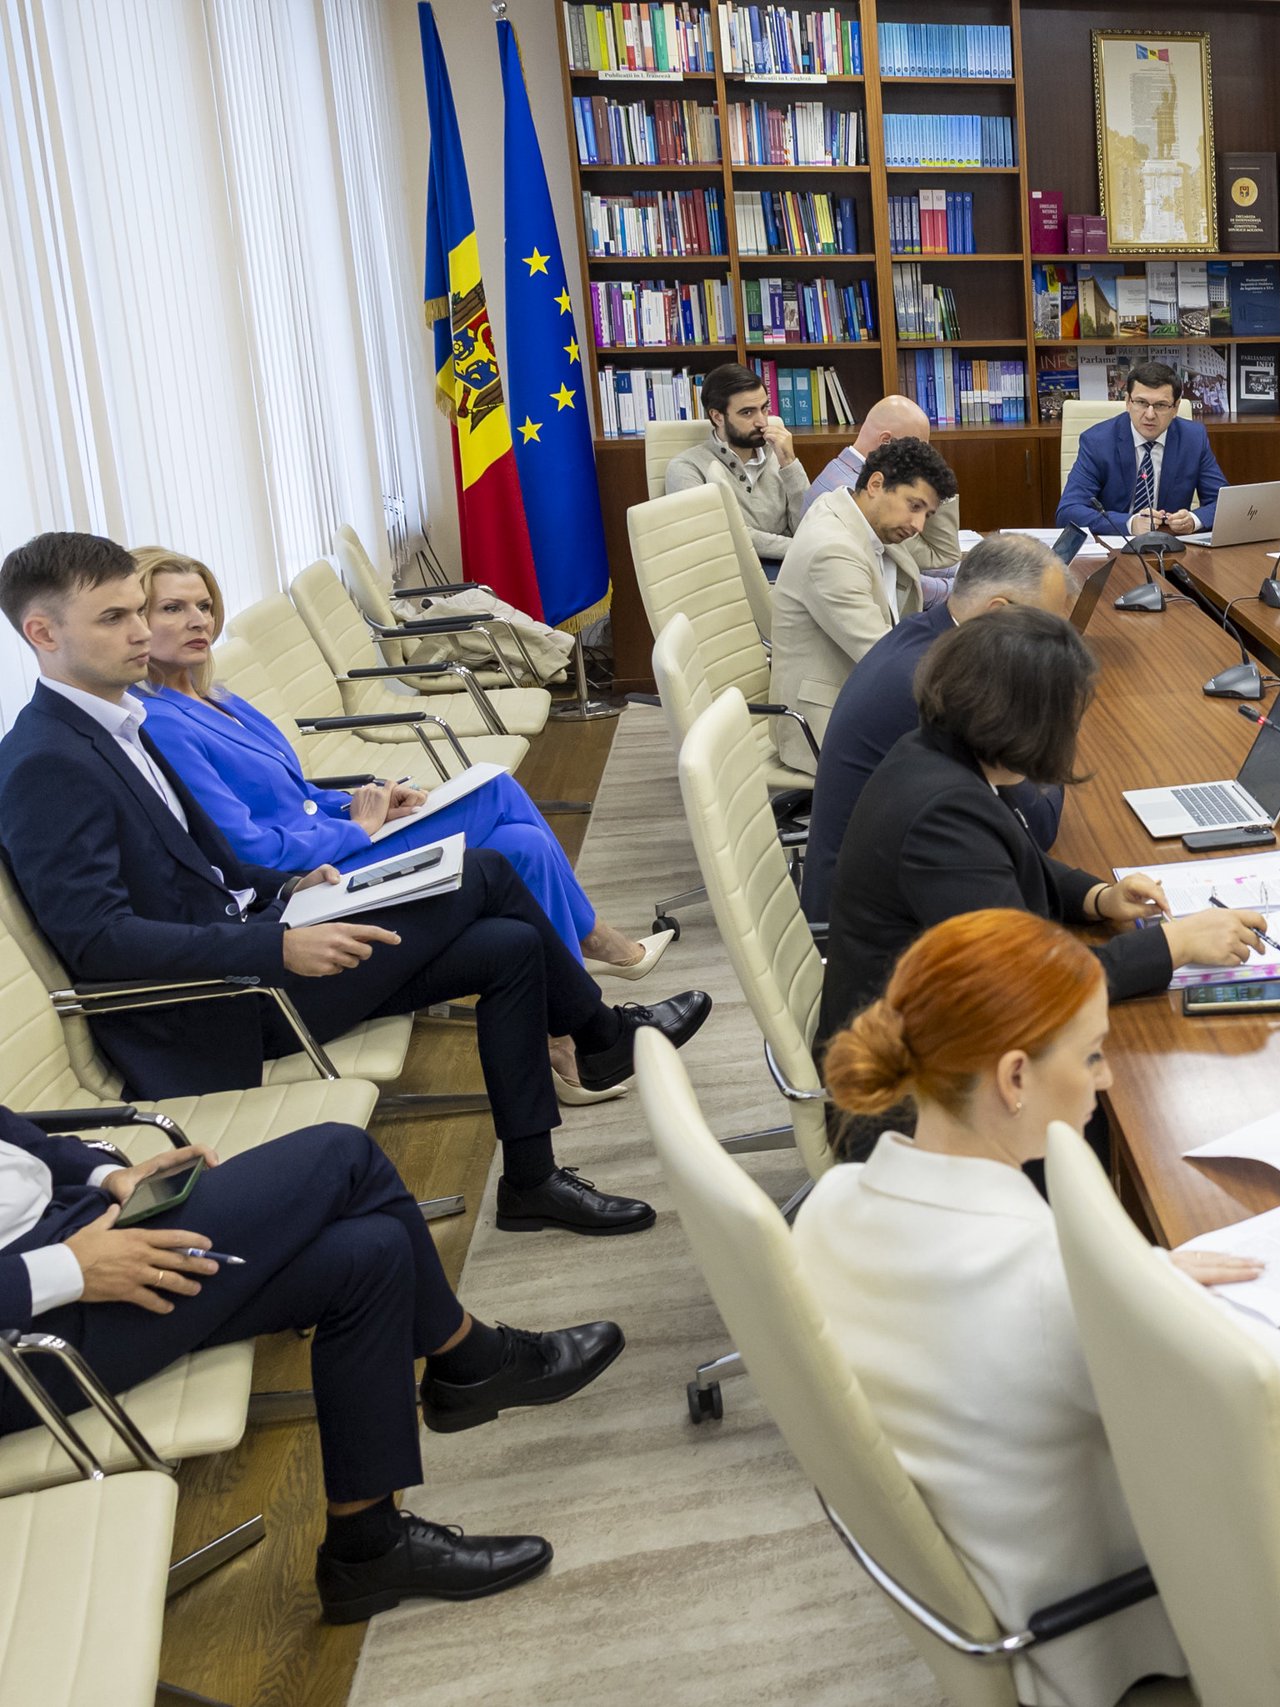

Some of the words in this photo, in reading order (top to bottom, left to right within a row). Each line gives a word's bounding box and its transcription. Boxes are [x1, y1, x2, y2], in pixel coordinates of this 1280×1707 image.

[1080, 356, 1116, 364] Parlame
[781, 398, 792, 408] 13.
[1247, 504, 1258, 520] hp
